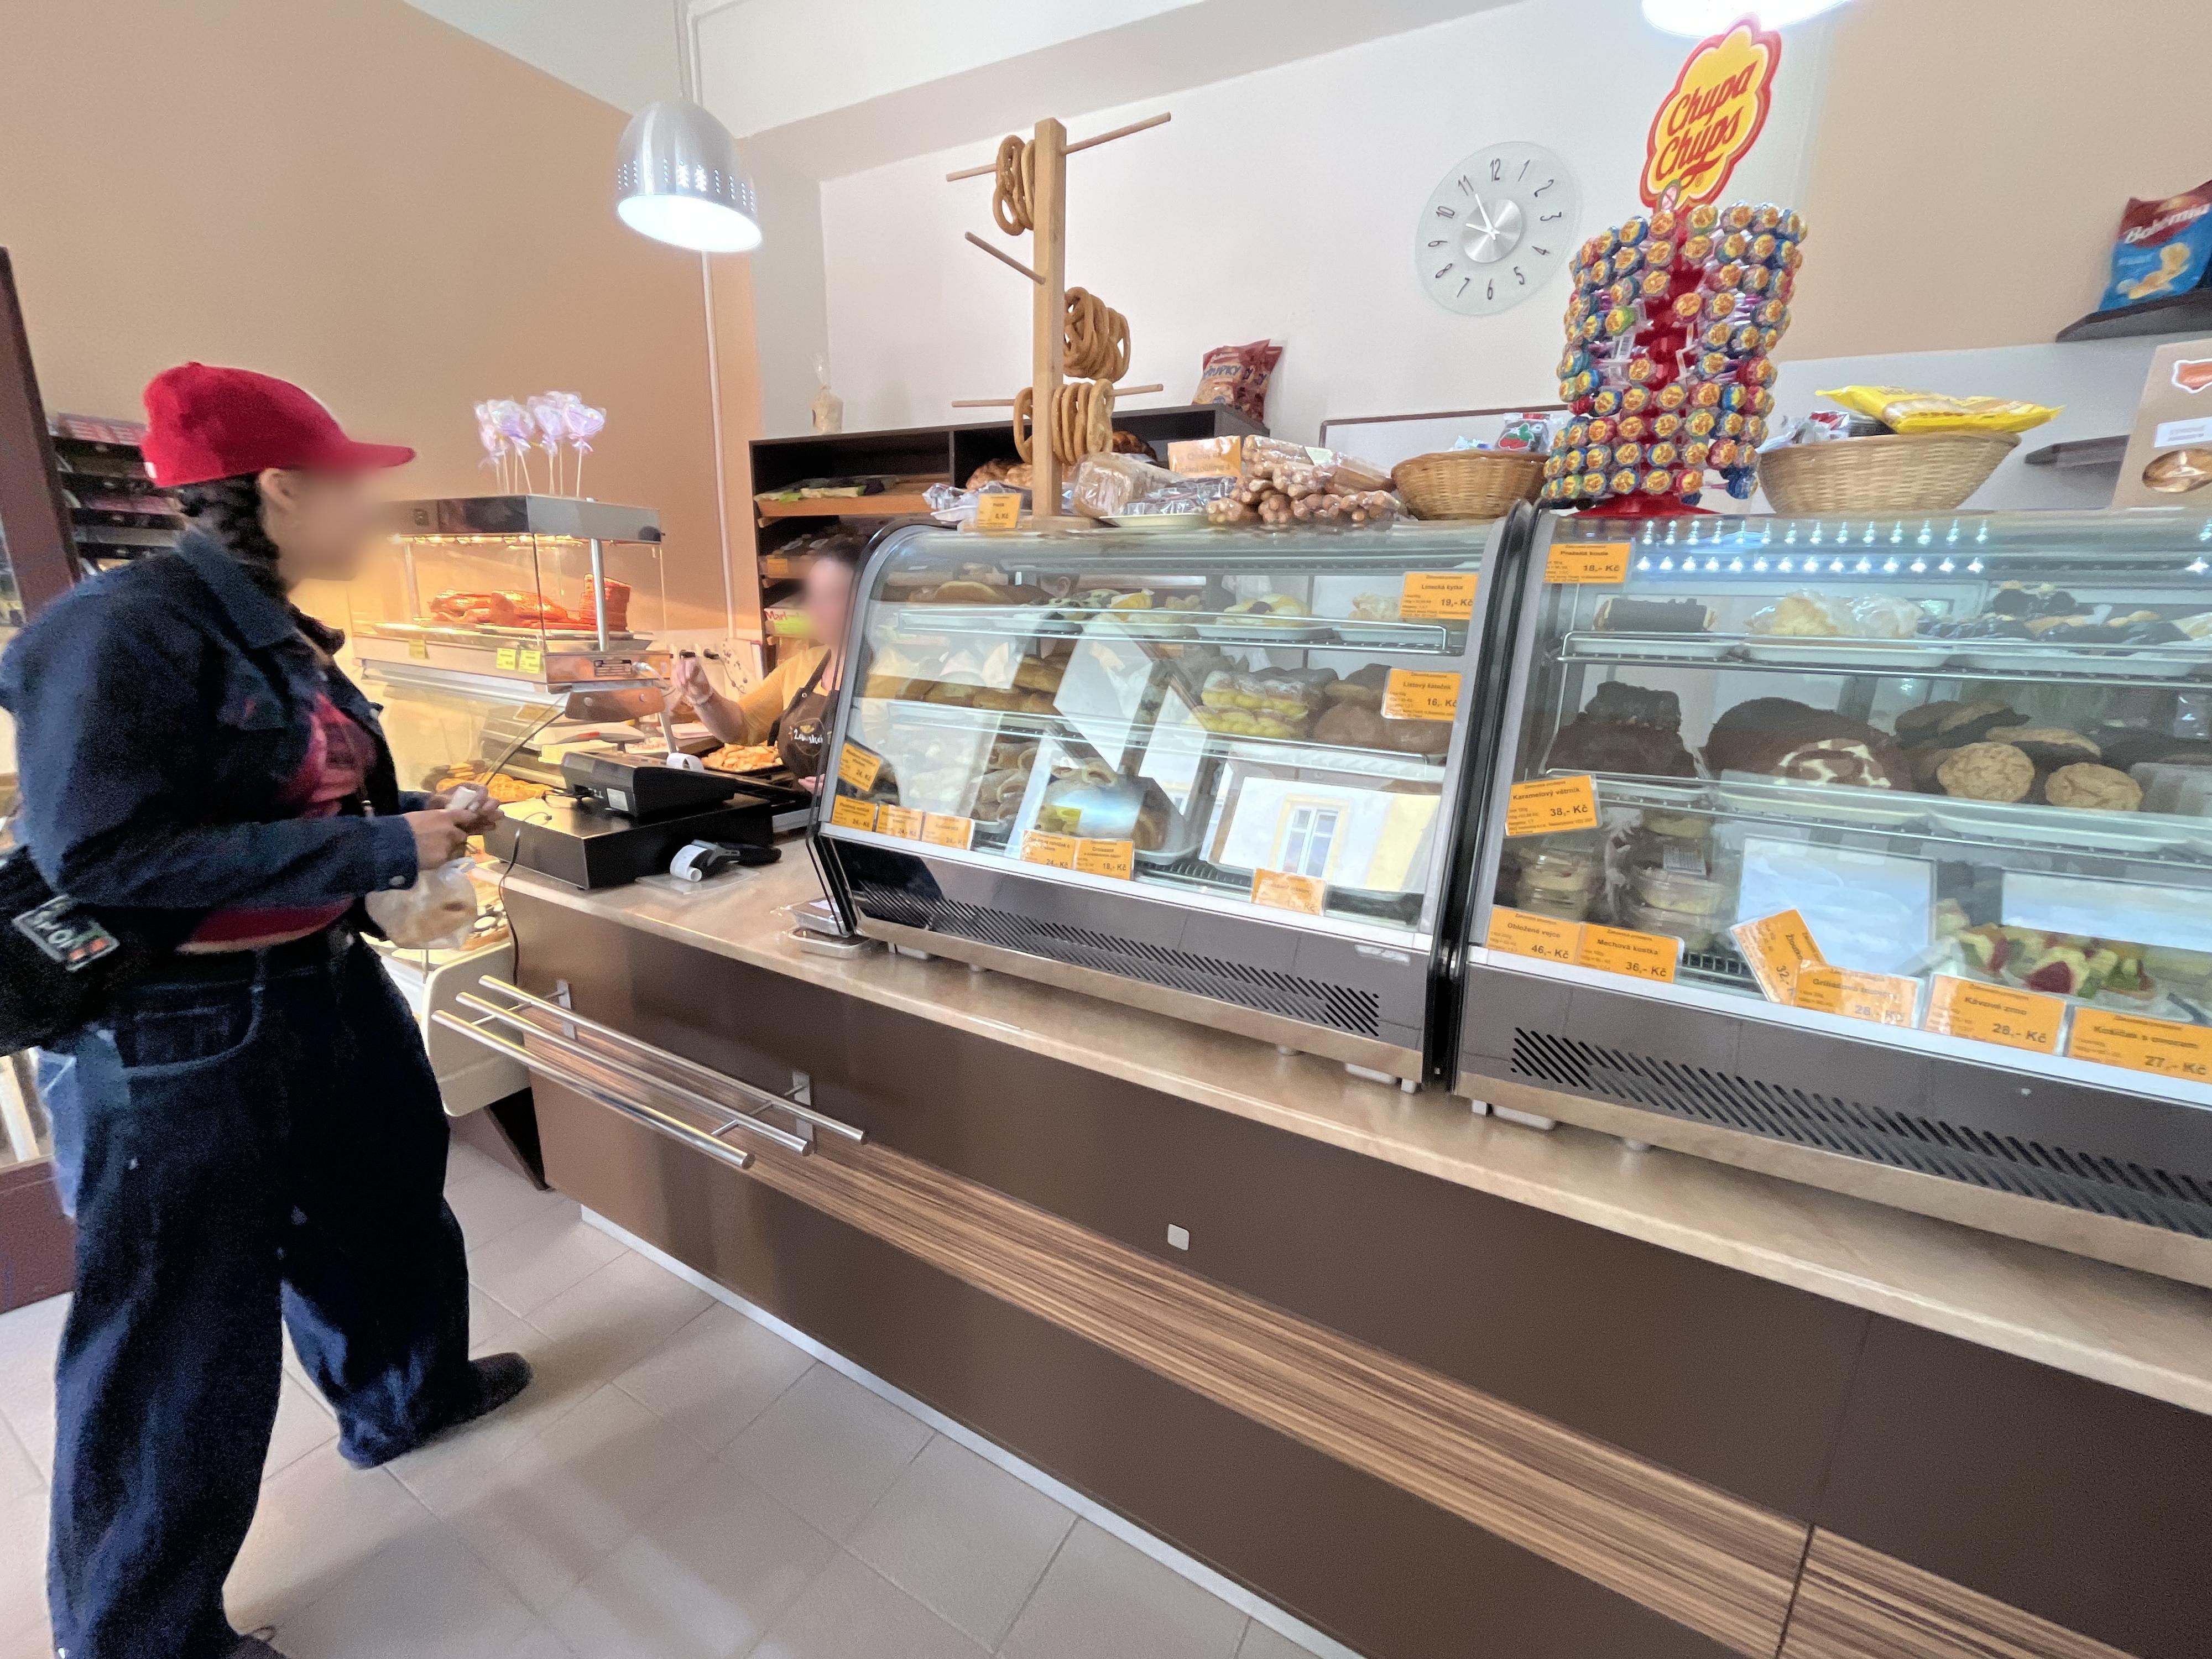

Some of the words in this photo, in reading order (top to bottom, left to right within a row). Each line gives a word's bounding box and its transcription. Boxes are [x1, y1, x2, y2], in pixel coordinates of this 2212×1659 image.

[1667, 60, 1759, 136] Chupa
[1656, 106, 1744, 181] Chups
[1490, 158, 1501, 182] 12
[1518, 159, 1530, 181] 1
[1458, 175, 1474, 196] 11
[1534, 179, 1554, 197] 2
[1436, 205, 1455, 219] 10
[1540, 211, 1562, 221] 3
[1532, 246, 1551, 255] 4
[1435, 263, 1453, 279] 8
[1514, 266, 1525, 285] 5
[1457, 277, 1470, 298] 7
[1487, 278, 1493, 300] 6
[1512, 791, 1553, 800] Karamelový
[1550, 807, 1570, 817] 38,-
[1573, 805, 1588, 813] Kč
[1507, 922, 1540, 934] Obložené
[1531, 945, 1552, 956] 46,-
[1554, 949, 1569, 959] Kč
[1651, 966, 1667, 977] Kč
[2026, 1030, 2047, 1044] Kč
[2183, 1062, 2206, 1075] Kč
